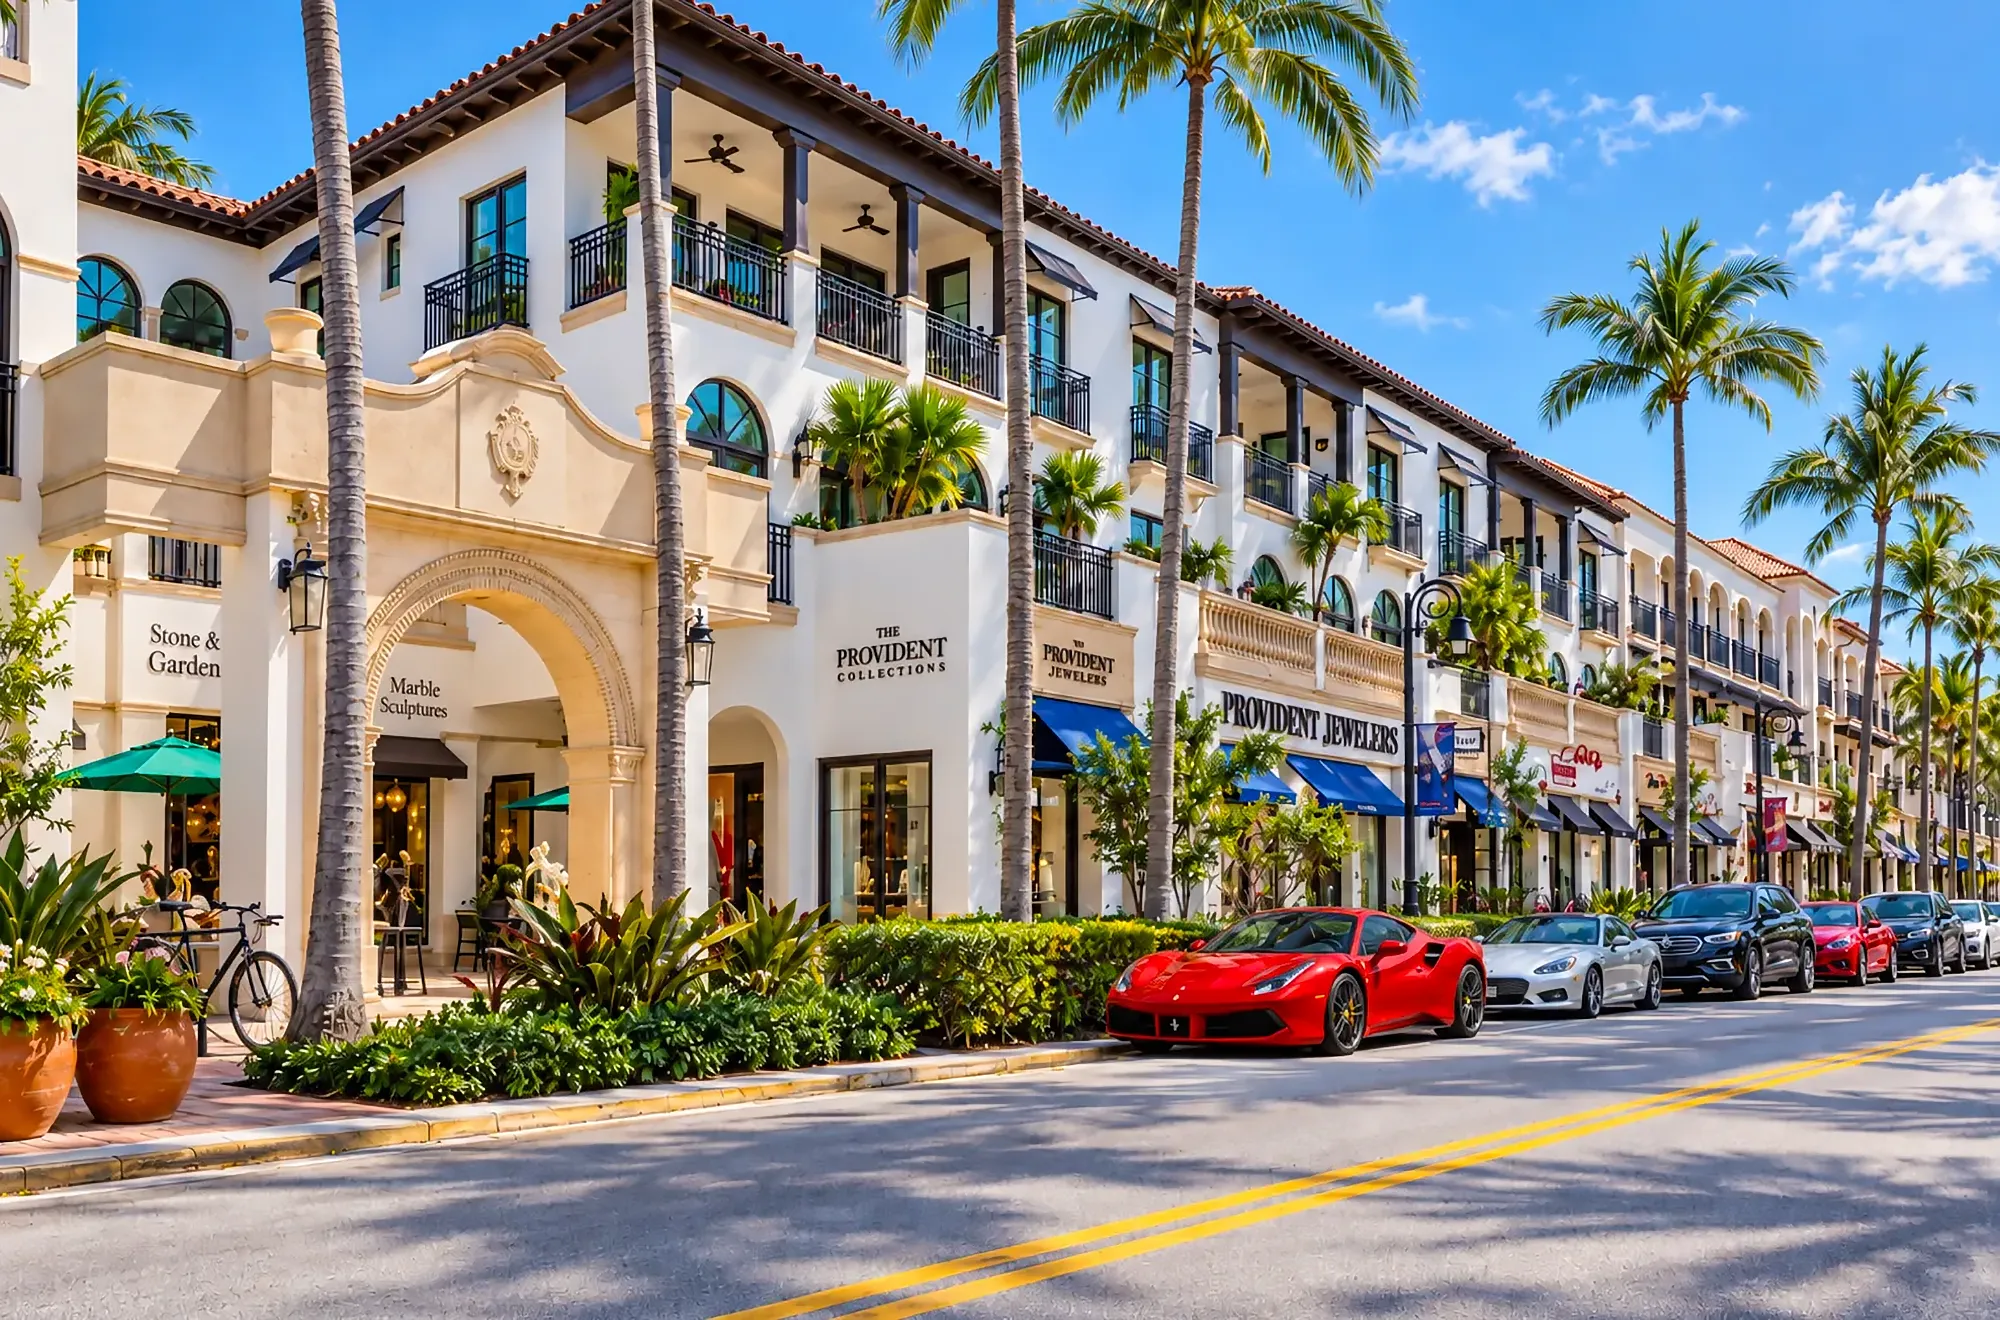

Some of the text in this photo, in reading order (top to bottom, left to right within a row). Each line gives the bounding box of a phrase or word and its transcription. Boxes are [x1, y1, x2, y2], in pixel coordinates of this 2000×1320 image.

[150, 623, 220, 651] Stone &
[876, 626, 900, 639] THE
[149, 650, 221, 678] Garden
[837, 637, 947, 668] PROVIDENT
[1043, 644, 1115, 673] PROVIDENT
[837, 662, 946, 683] COLLECTIONS
[1048, 666, 1107, 686] JEWELERS
[390, 676, 440, 698] Marble
[379, 697, 448, 720] Sculptures
[1221, 691, 1398, 755] PROVIDENT JEWELERS
